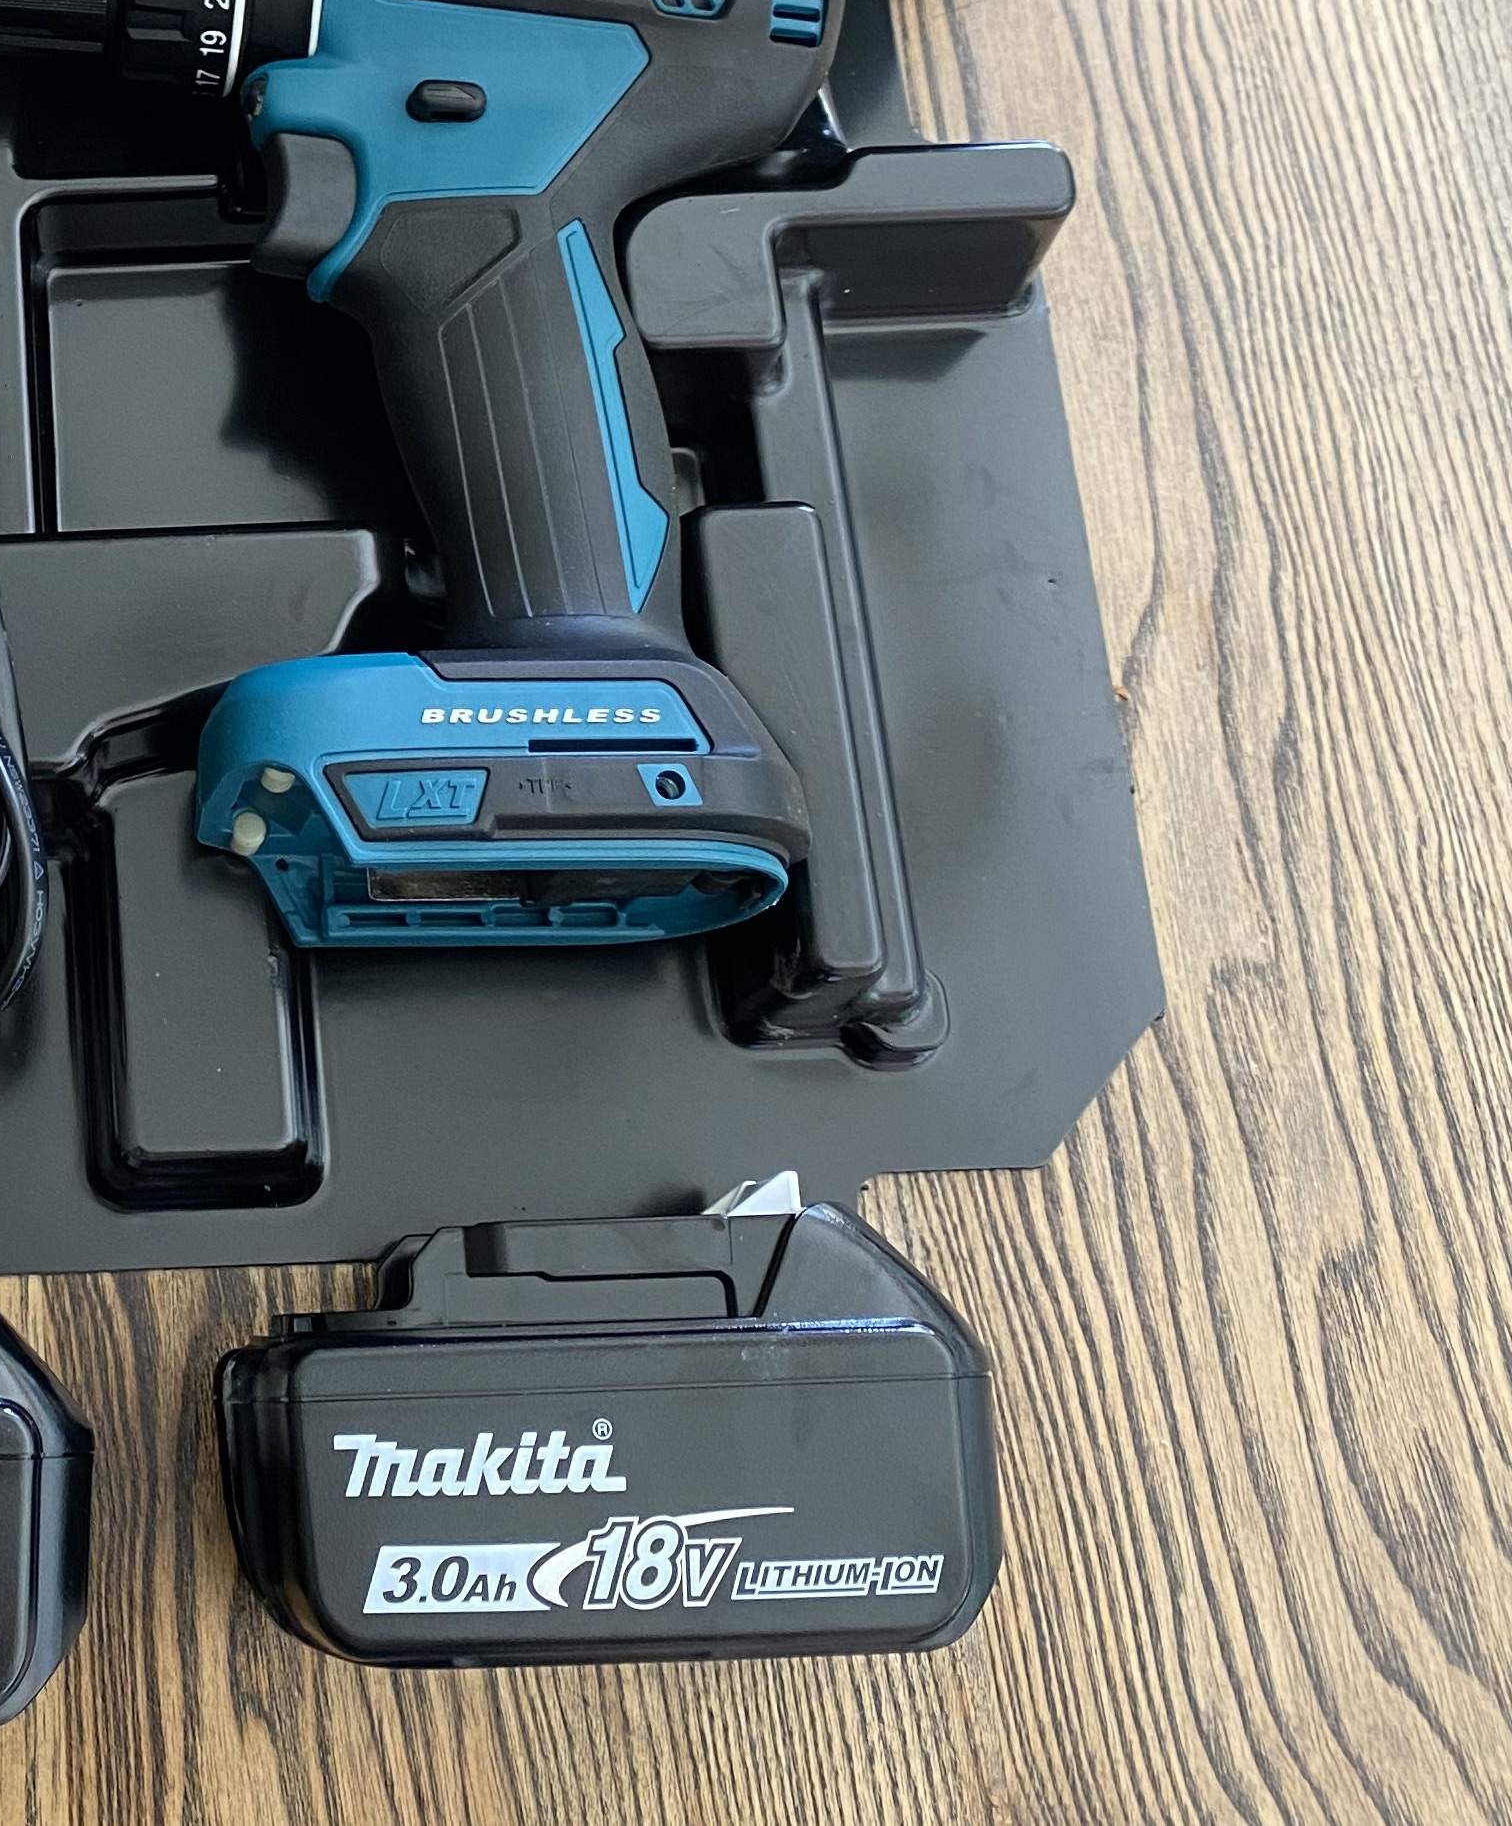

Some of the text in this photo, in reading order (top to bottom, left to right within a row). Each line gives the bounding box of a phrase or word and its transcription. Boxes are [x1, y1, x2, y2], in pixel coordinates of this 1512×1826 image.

[199, 30, 227, 56] 19
[420, 707, 663, 725] BRUSHLESS
[375, 776, 480, 820] LXT
[333, 1430, 628, 1497] makita
[382, 1515, 945, 1609] 3.0Ah 18V LITHIUM-ION
